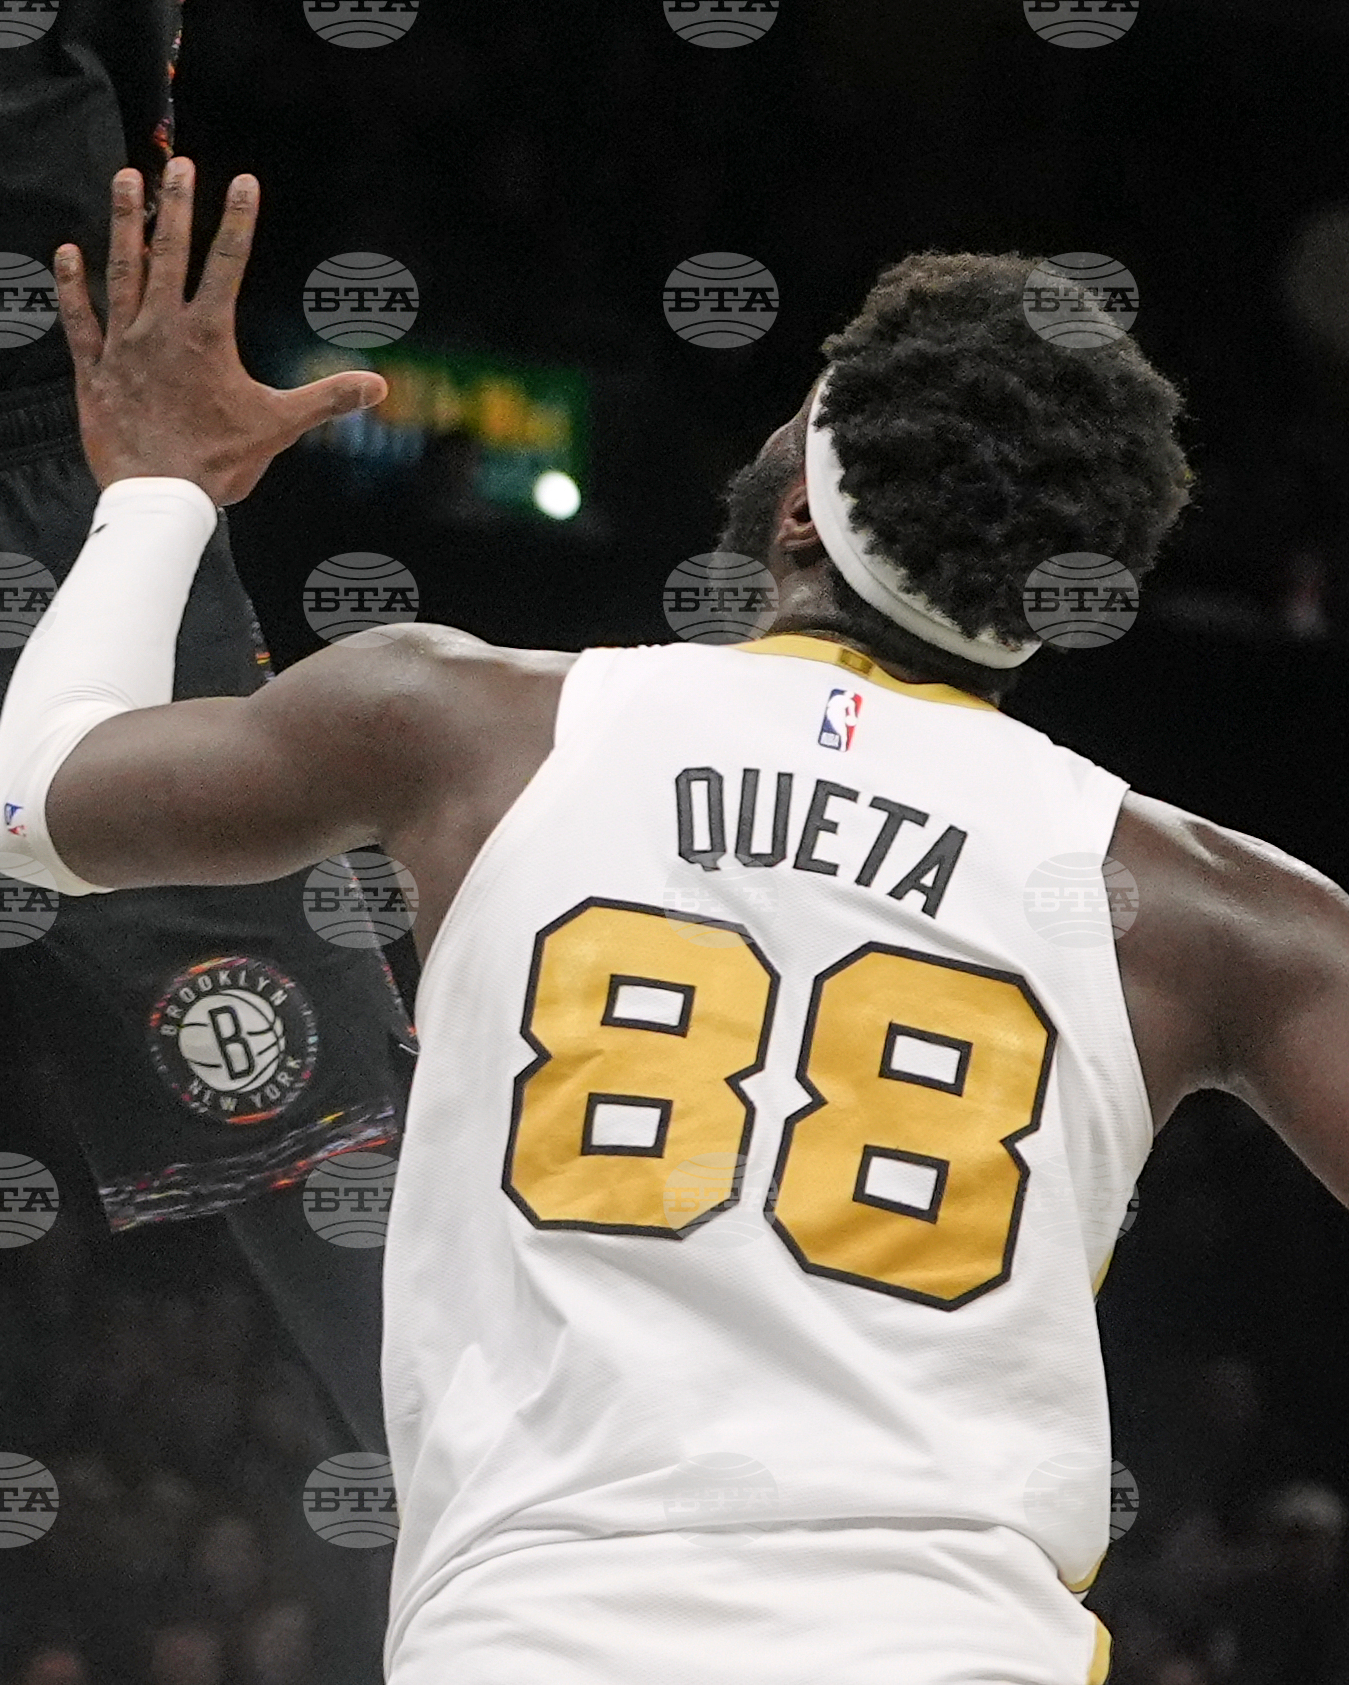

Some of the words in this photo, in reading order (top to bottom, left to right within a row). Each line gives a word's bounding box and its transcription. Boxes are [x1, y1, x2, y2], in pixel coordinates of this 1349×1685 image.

[675, 766, 968, 920] QUETA
[159, 969, 289, 1037] BROOKLYN
[209, 1005, 255, 1081] B
[250, 1056, 302, 1109] YORK
[501, 896, 1059, 1312] 88
